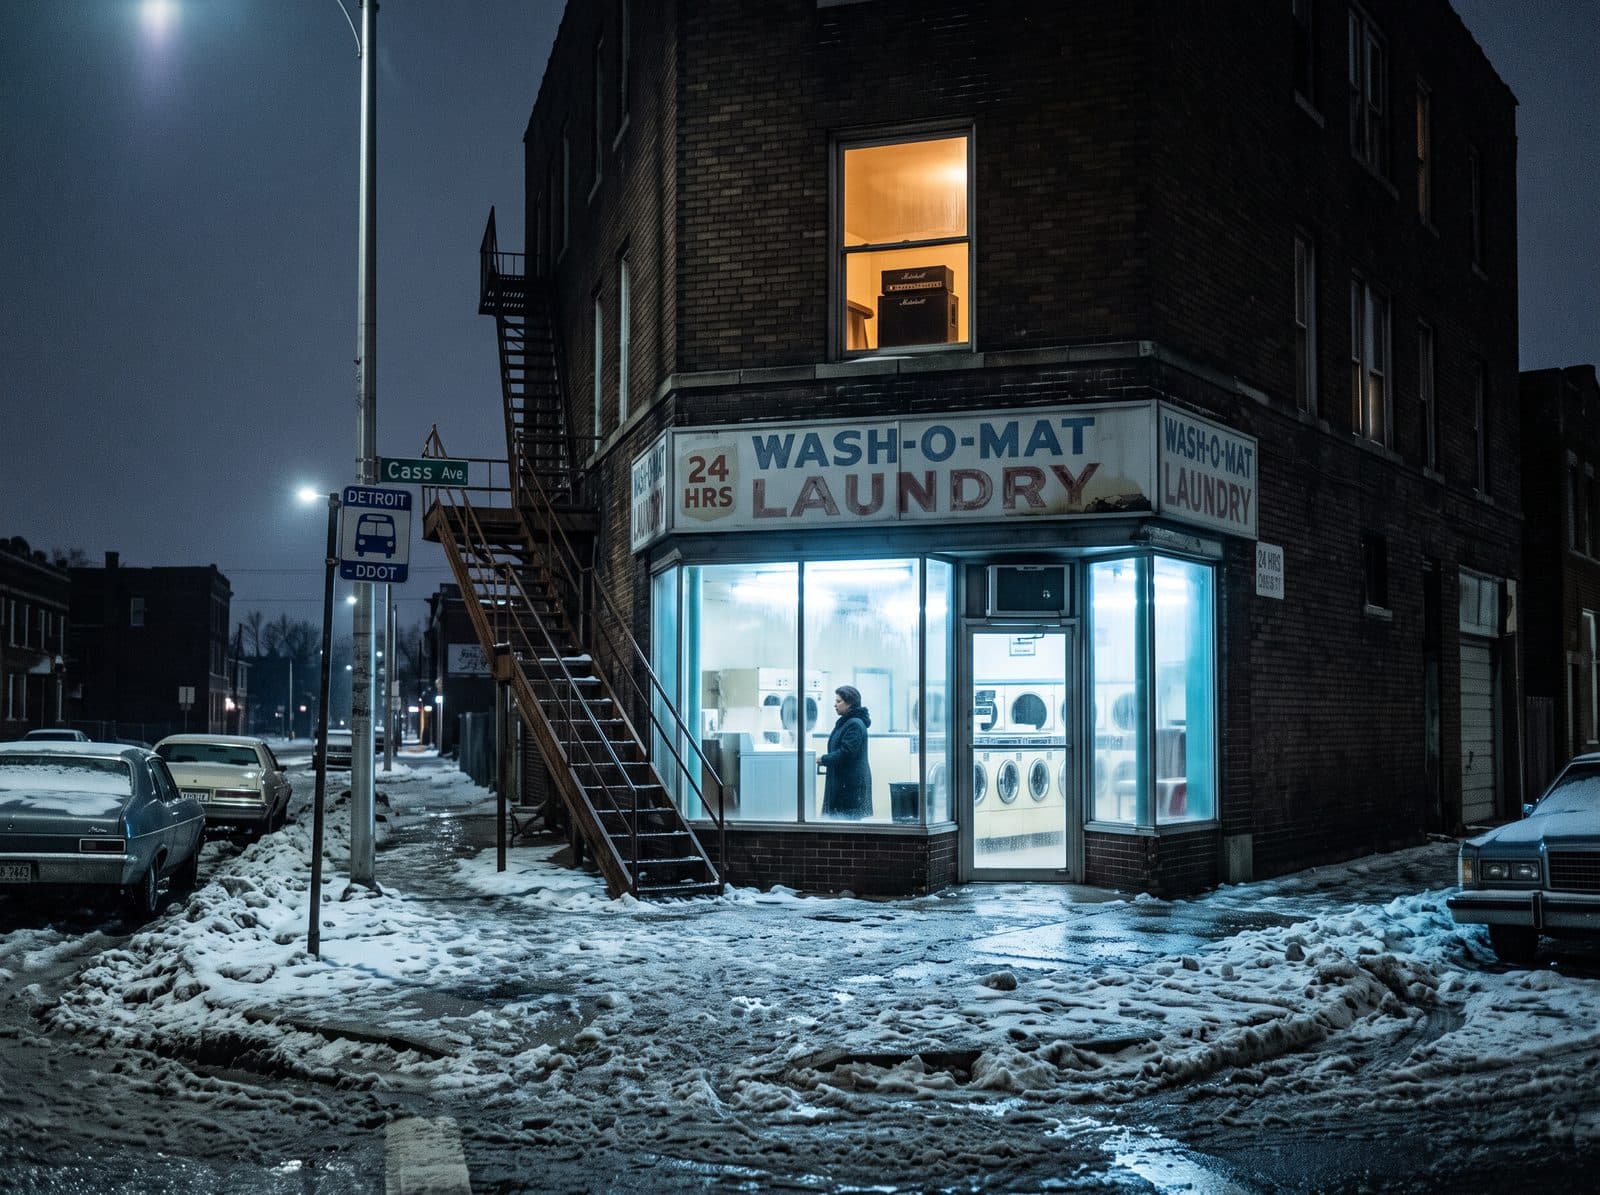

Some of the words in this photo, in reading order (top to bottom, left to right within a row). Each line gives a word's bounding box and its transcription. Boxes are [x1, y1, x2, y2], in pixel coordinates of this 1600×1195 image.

[752, 416, 1095, 470] WASH-O-MAT
[1164, 416, 1252, 479] WASH-O-MAT
[388, 462, 432, 480] Cass
[441, 467, 463, 480] Ave
[688, 454, 729, 484] 24
[348, 490, 407, 506] DETROIT
[684, 486, 733, 509] HRS
[752, 462, 1101, 519] LAUNDRY
[1165, 462, 1252, 525] LAUNDRY
[356, 564, 397, 579] DDOT
[1258, 549, 1267, 570] 24
